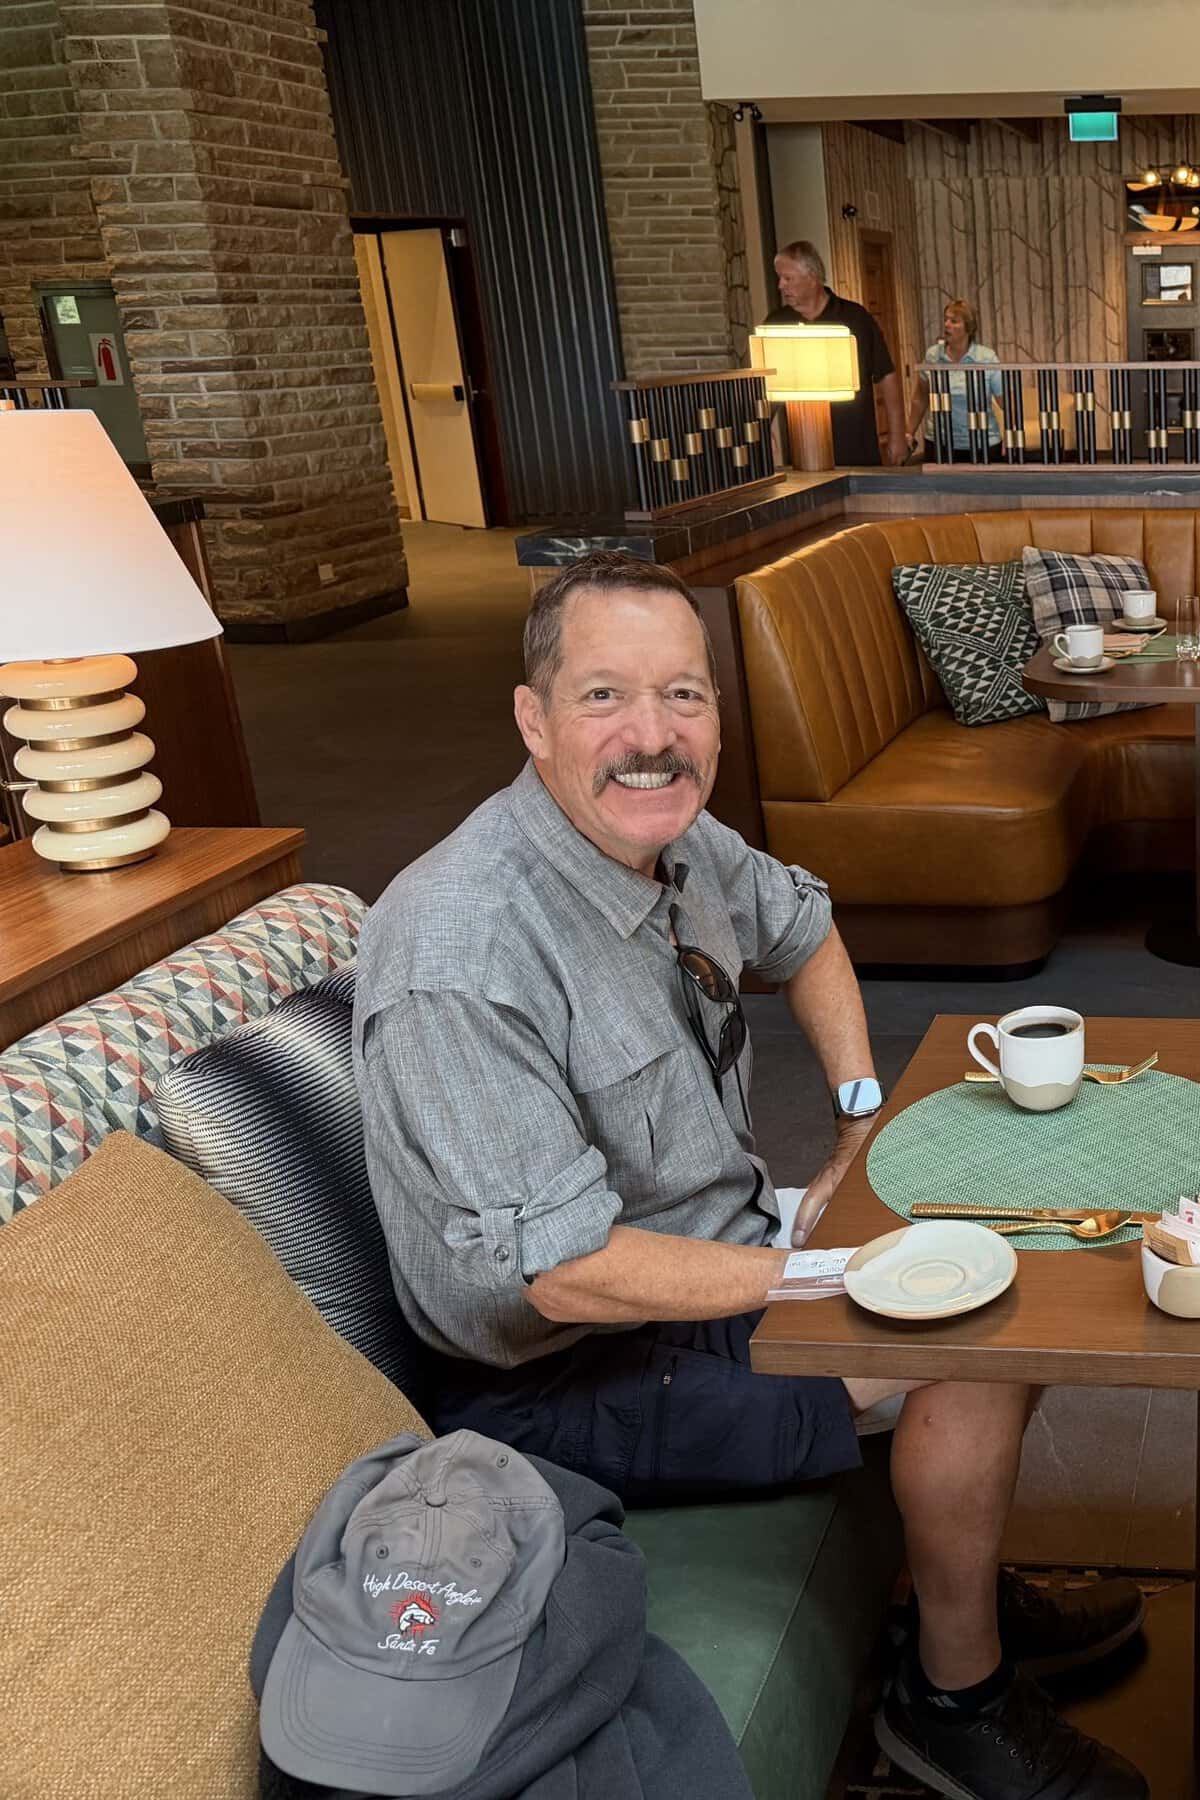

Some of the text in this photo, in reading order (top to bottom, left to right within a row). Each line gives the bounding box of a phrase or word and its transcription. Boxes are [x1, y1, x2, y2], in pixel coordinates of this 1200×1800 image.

[363, 1573, 391, 1598] High
[392, 1571, 440, 1594] Desert
[377, 1633, 440, 1655] Santa Fe
